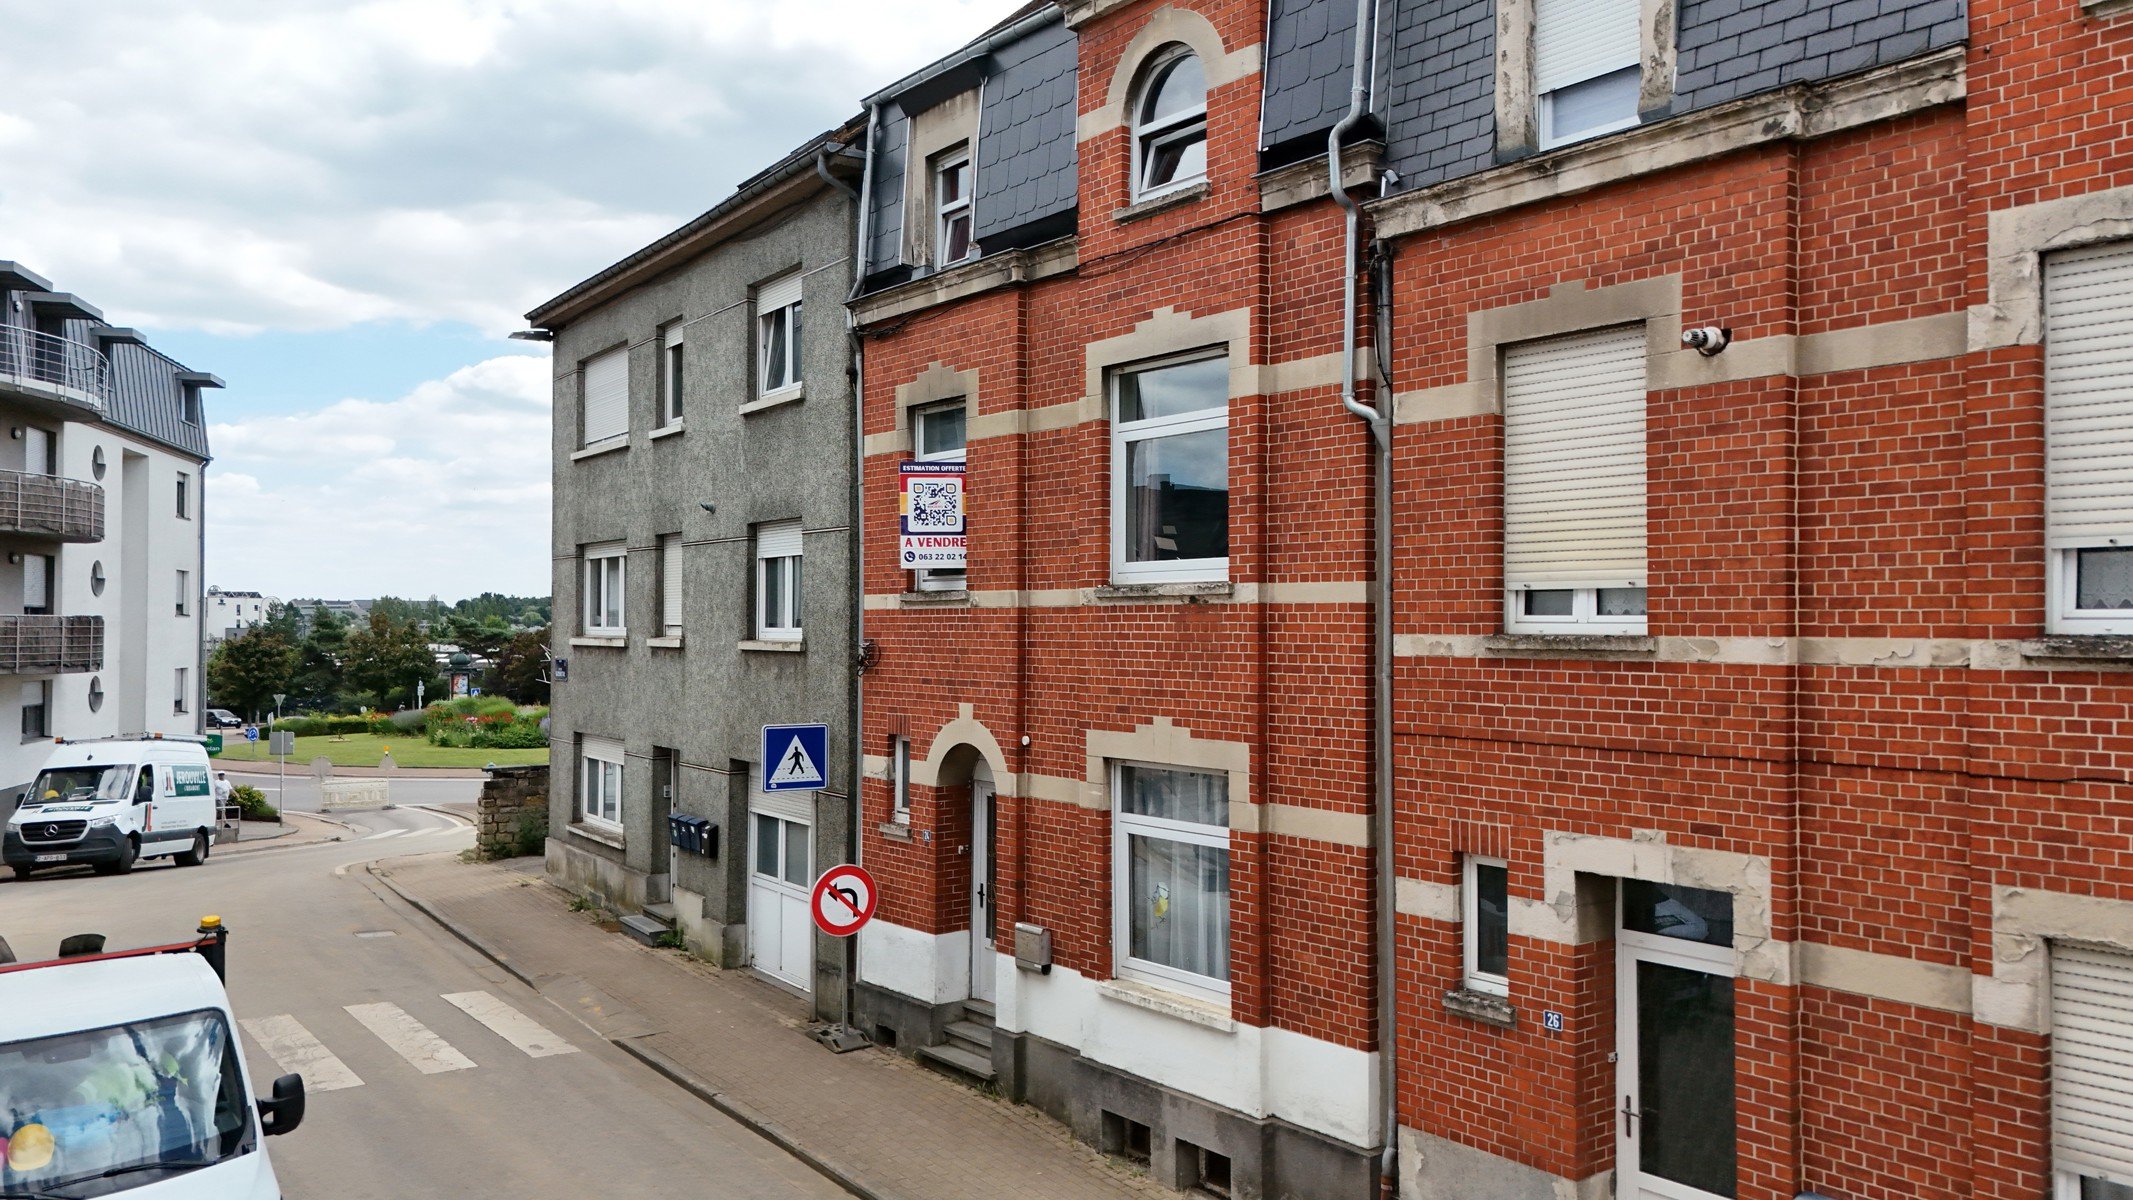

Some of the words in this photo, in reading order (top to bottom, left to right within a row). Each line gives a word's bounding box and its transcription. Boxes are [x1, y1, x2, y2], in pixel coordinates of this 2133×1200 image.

[905, 537, 913, 547] A
[917, 537, 967, 547] VENDRE
[176, 770, 206, 784] JEROUVILLE
[1547, 1013, 1559, 1028] 26
